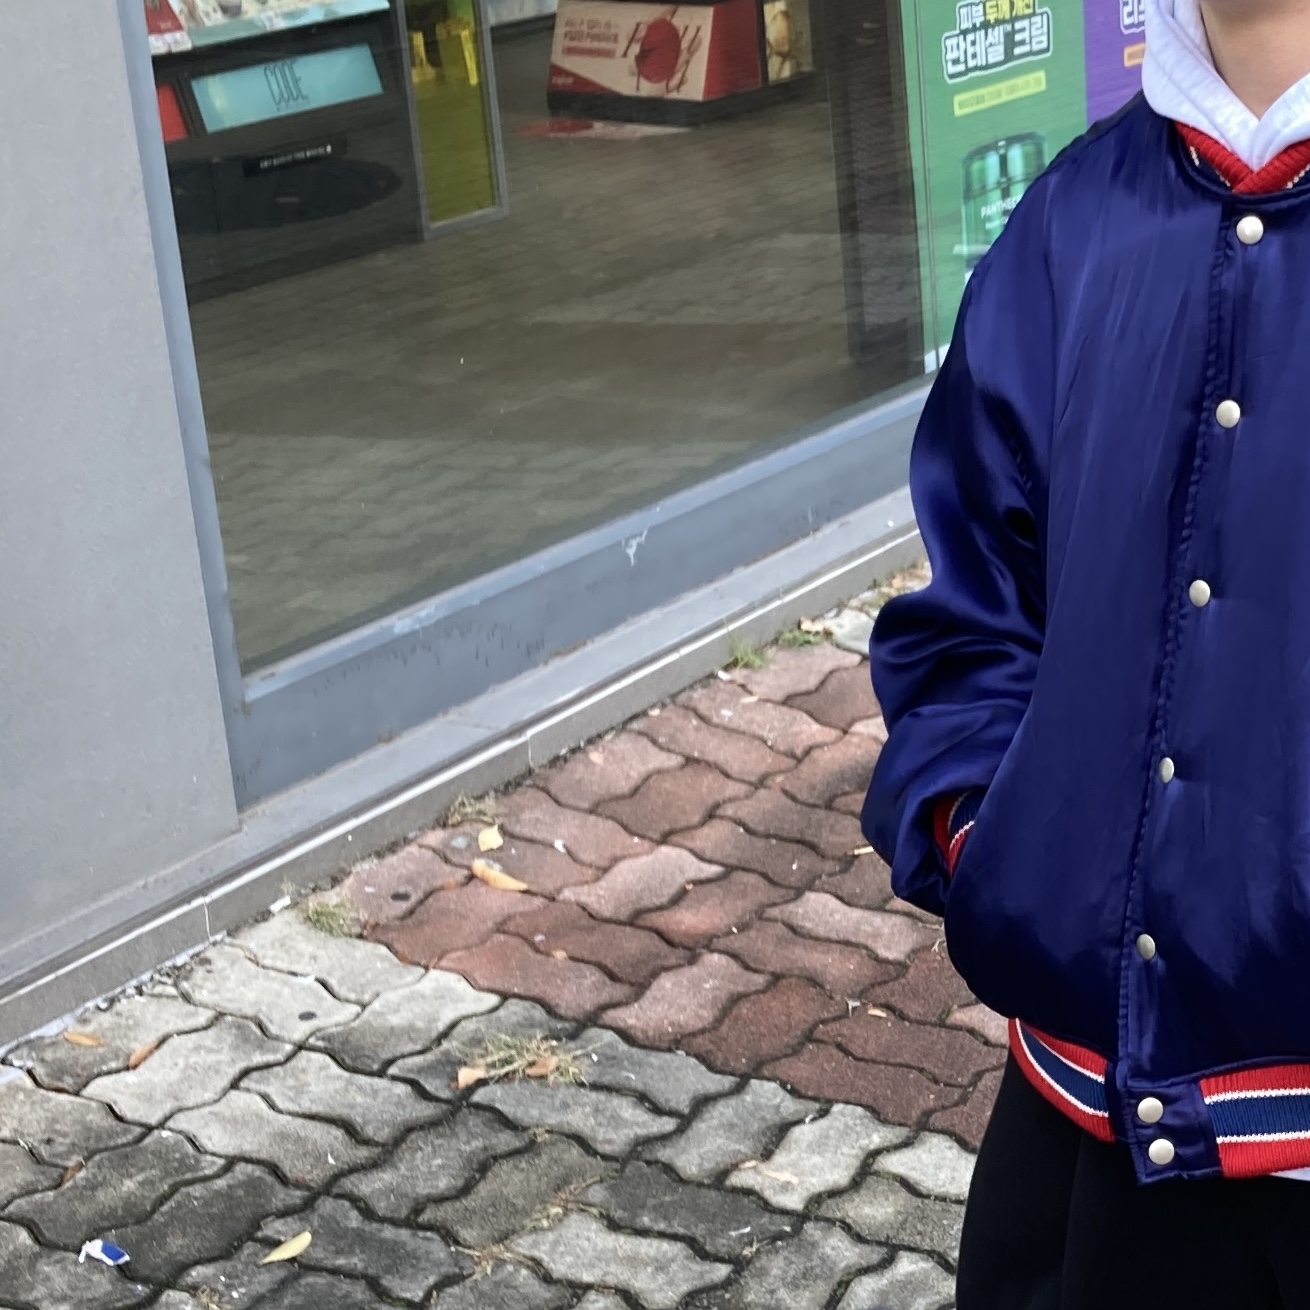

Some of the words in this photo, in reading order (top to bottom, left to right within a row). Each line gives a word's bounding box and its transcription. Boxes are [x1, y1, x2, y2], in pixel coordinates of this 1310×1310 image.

[960, 3, 985, 30] 피부
[985, 1, 1011, 24] 두께
[1013, 13, 1048, 56] 크림
